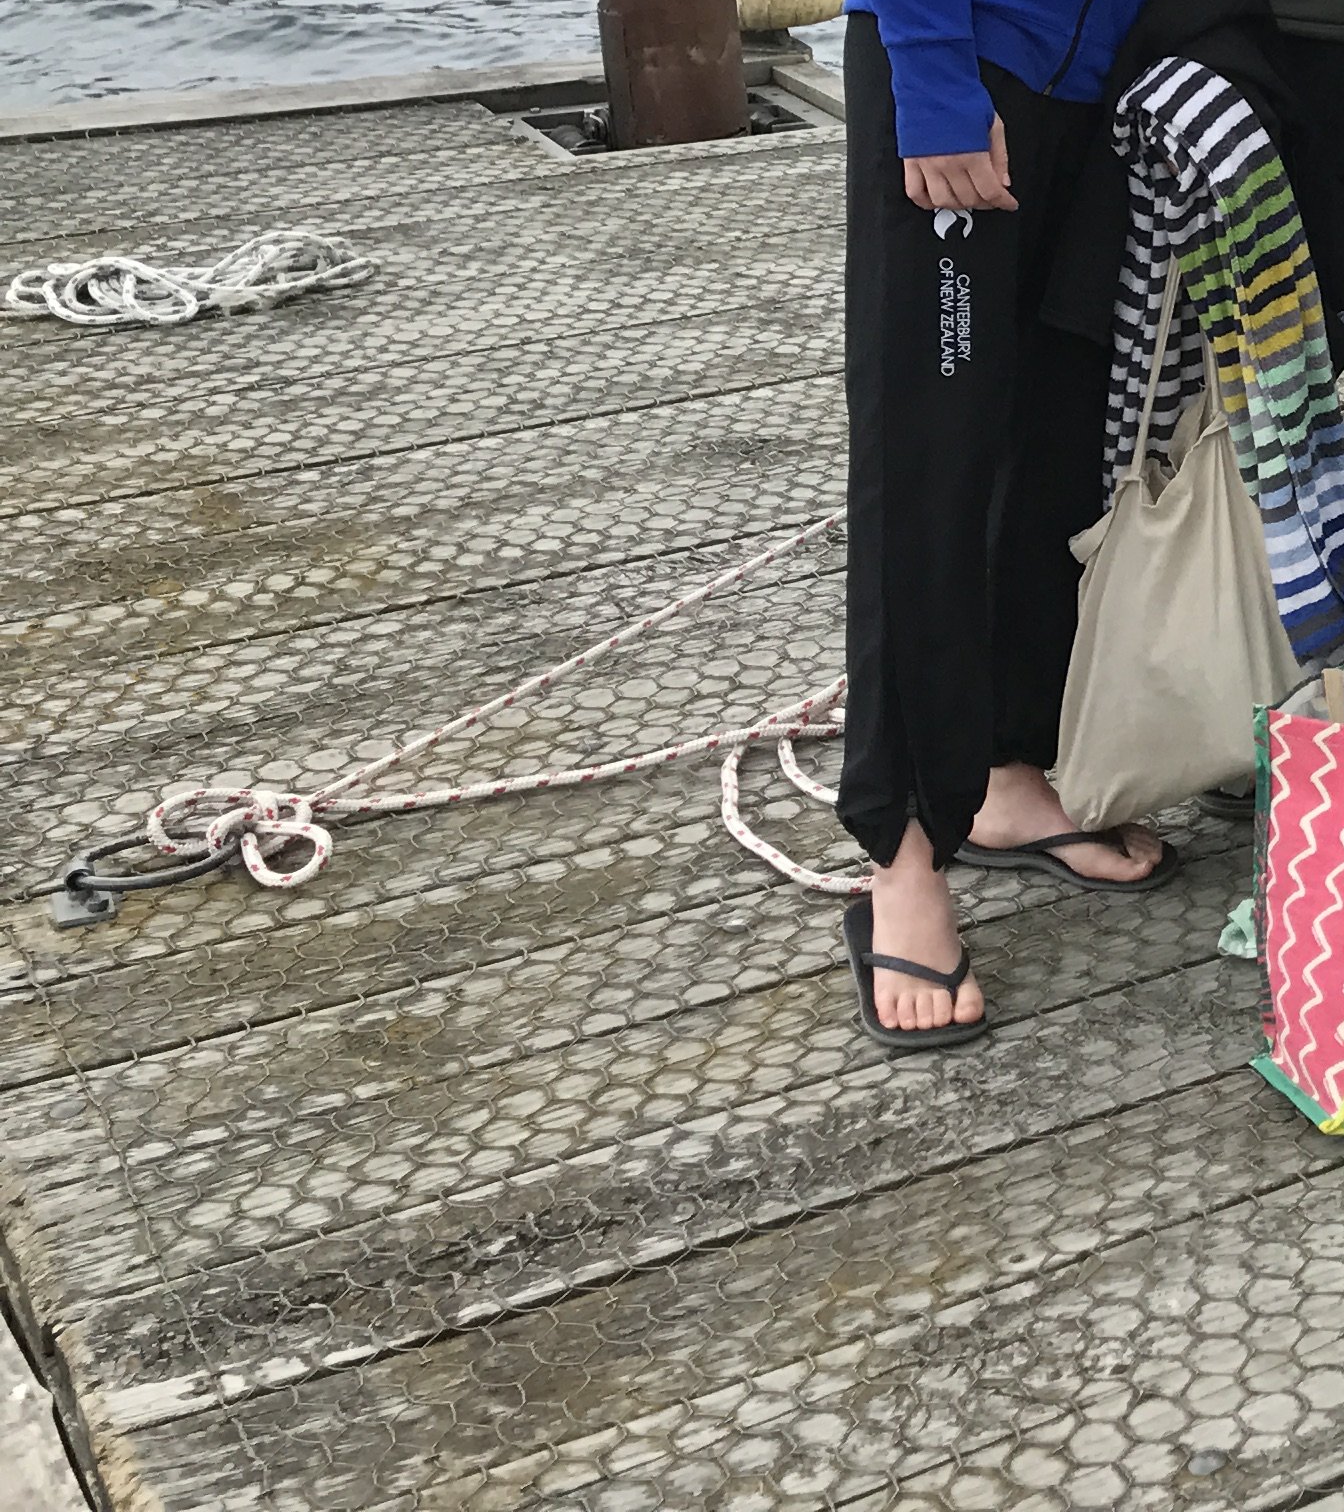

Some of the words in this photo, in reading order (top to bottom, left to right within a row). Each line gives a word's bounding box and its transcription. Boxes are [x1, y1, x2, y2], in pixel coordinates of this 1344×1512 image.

[939, 257, 954, 278] OF
[940, 279, 954, 312] NEW
[956, 274, 971, 361] CANTERBURY
[940, 313, 955, 377] ZEALAND
